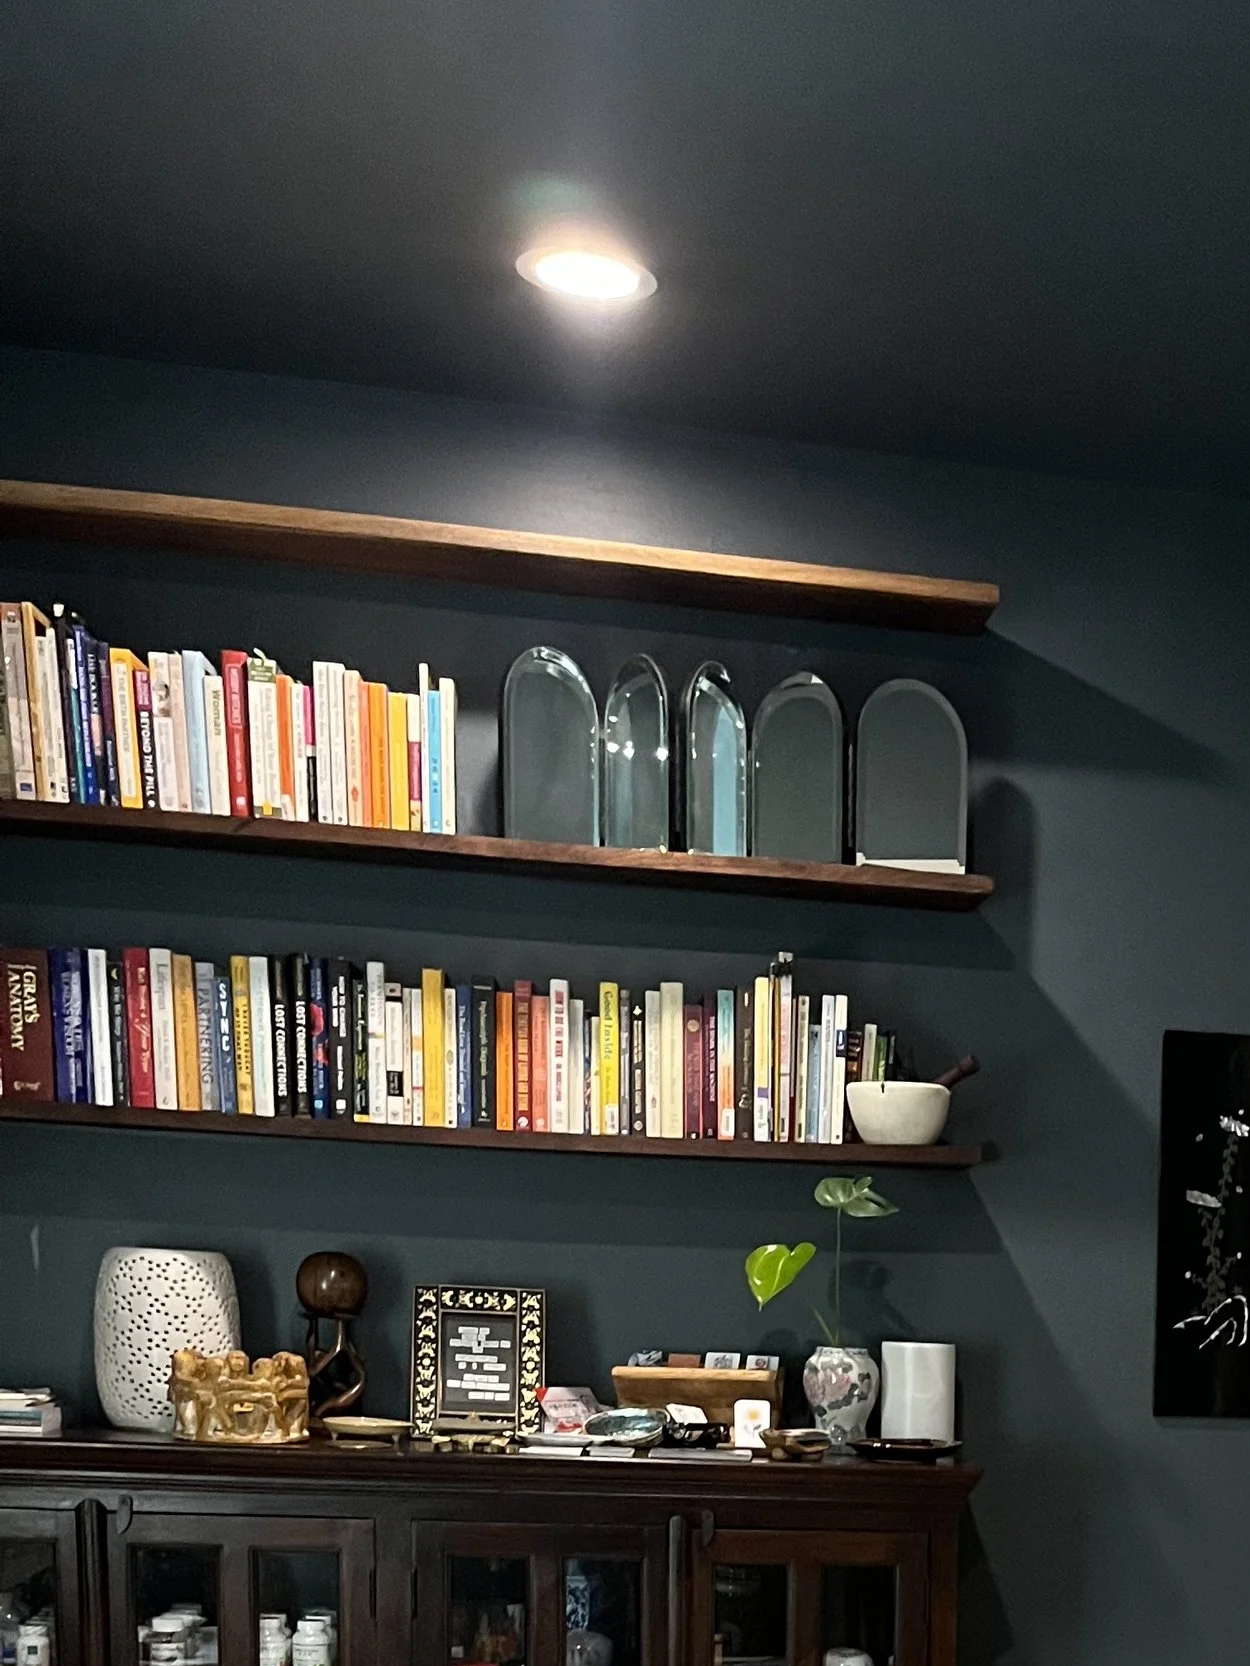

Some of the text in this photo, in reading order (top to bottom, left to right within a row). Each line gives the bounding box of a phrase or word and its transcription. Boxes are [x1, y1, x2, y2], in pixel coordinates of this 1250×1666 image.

[140, 711, 152, 752] BEYOND
[212, 690, 221, 736] Woman
[144, 755, 153, 773] THE
[145, 776, 155, 796] PILL
[8, 971, 24, 1051] ANATOMY
[23, 971, 40, 1023] GRAY'S
[155, 964, 168, 1010] Lifespan
[198, 988, 214, 1085] PARTNERING
[219, 983, 230, 1052] SYNC
[295, 1001, 307, 1093] LOST CONNECTIONS
[604, 991, 614, 1060] Good Inside
[275, 1004, 287, 1097] LOST CONNECTIONS
